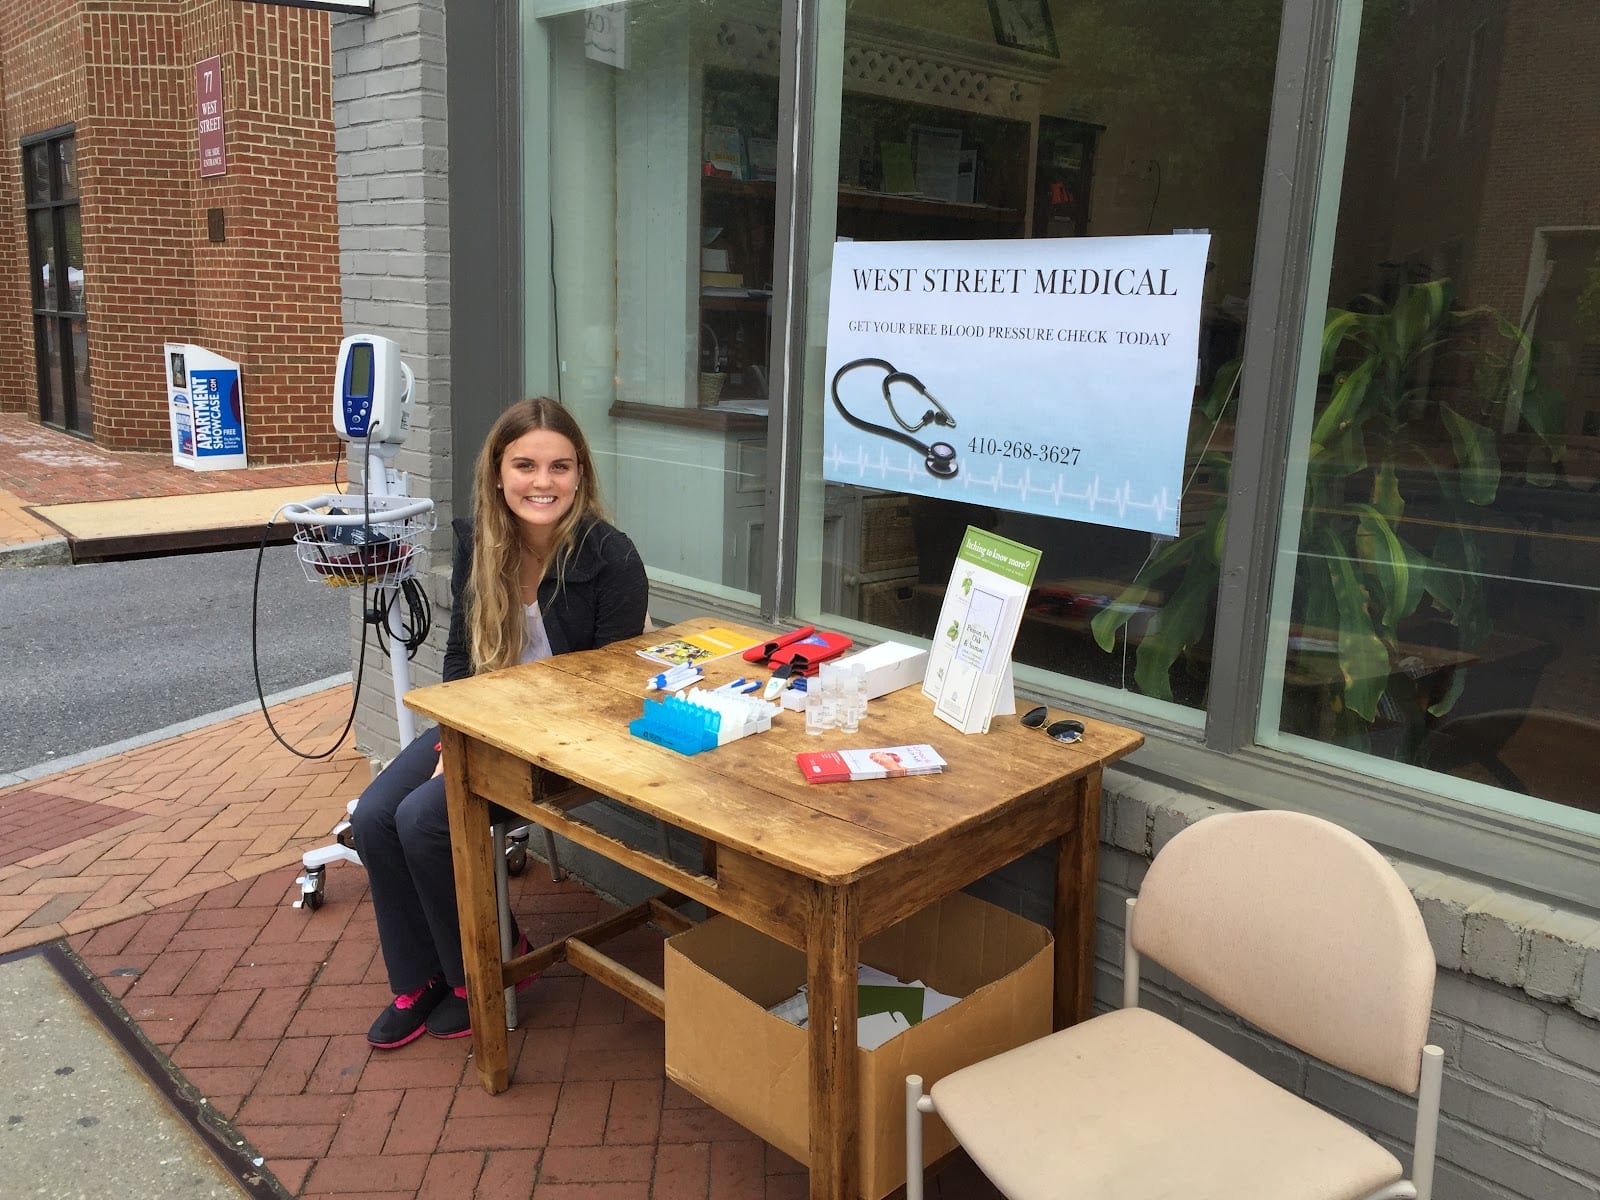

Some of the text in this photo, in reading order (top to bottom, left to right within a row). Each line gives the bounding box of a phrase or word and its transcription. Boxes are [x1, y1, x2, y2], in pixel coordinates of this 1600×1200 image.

[204, 71, 212, 94] 77
[202, 100, 217, 115] WEST
[200, 116, 221, 133] STREET
[853, 268, 1178, 296] WEST STREET MEDICAL
[848, 320, 1171, 346] GET YOUR FREE BLOOD PRESSURE CHECK TODAY
[192, 377, 213, 449] APARTMENT
[209, 394, 223, 449] SHOWCASE
[967, 436, 1081, 467] 410-268-3627
[992, 548, 1009, 562] know
